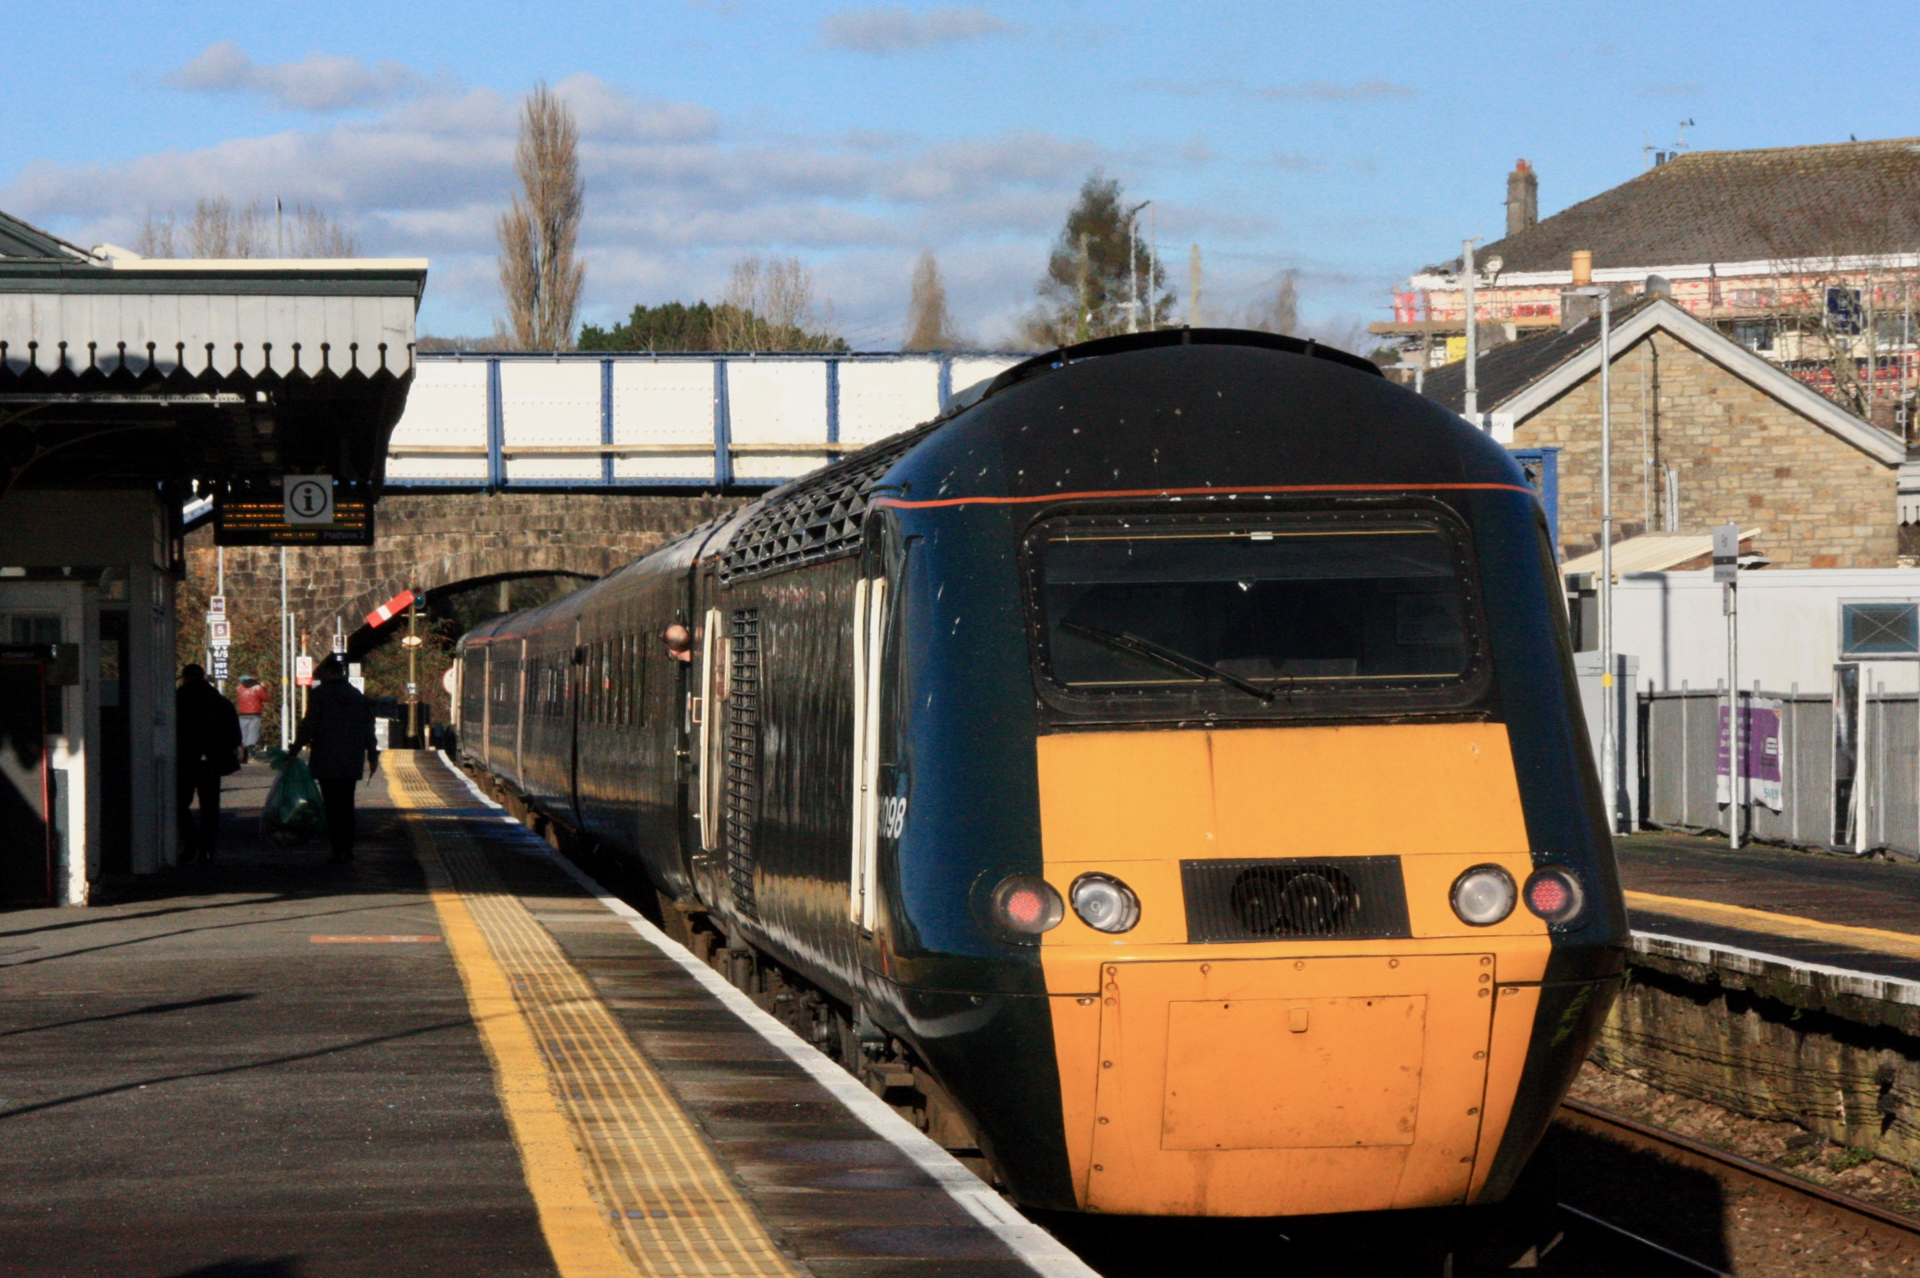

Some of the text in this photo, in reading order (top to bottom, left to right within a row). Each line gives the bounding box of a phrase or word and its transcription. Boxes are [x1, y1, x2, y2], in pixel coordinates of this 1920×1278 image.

[323, 531, 358, 540] Platform
[359, 531, 366, 539] 2
[217, 625, 224, 634] 5
[213, 650, 228, 658] 4/5
